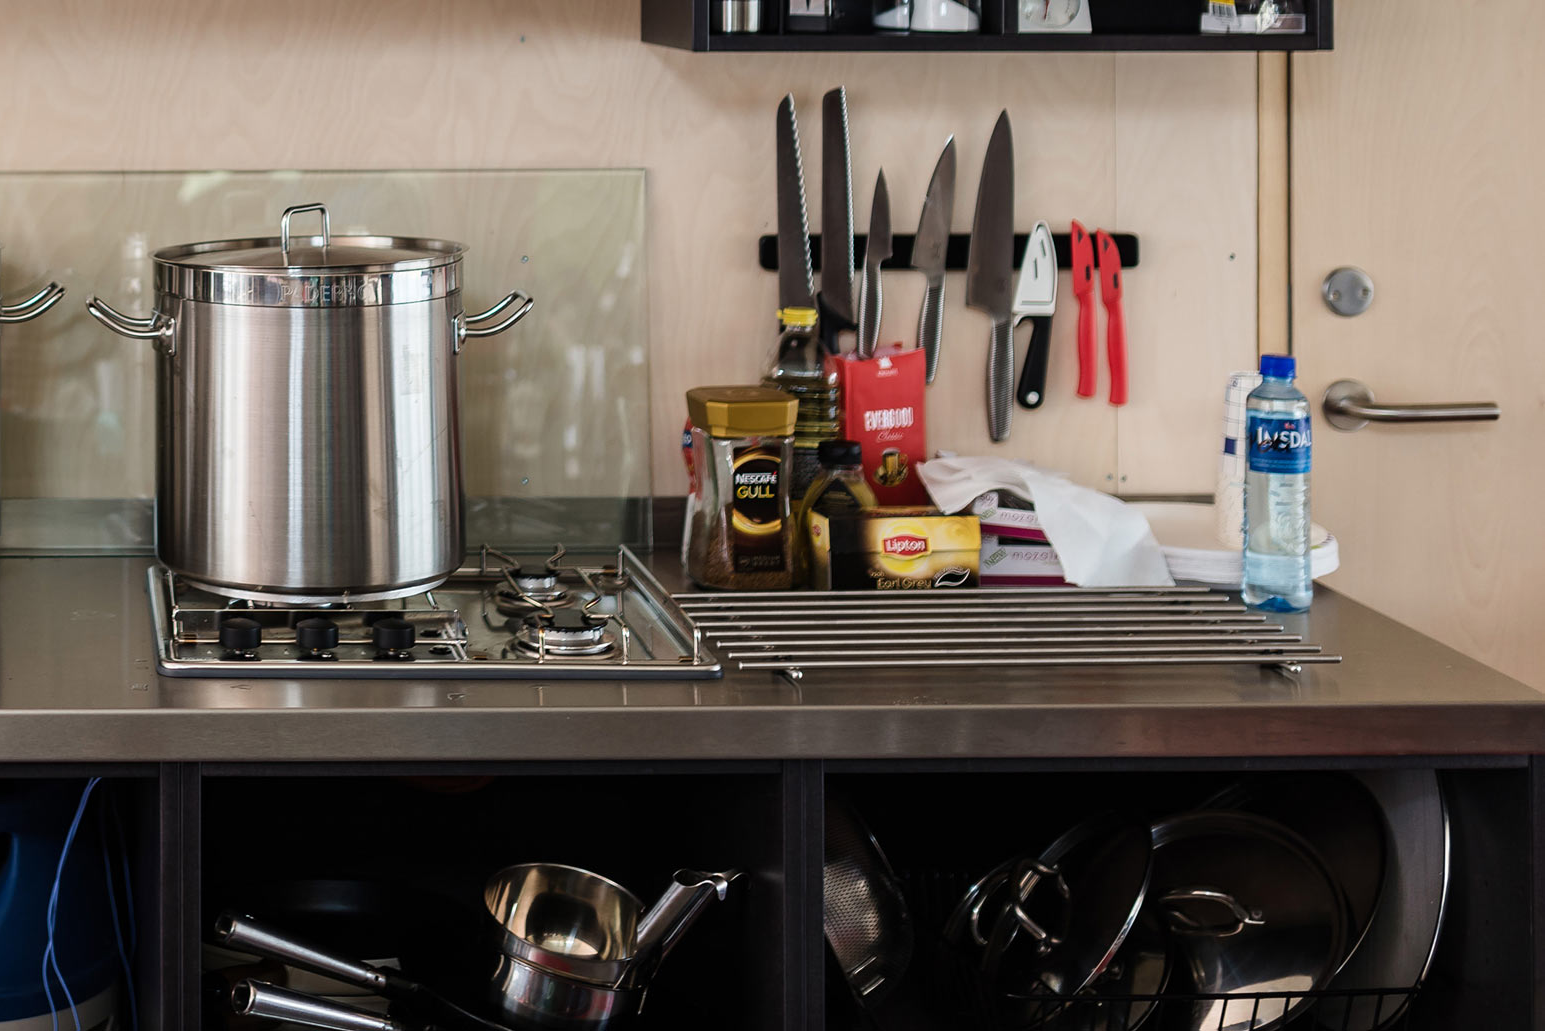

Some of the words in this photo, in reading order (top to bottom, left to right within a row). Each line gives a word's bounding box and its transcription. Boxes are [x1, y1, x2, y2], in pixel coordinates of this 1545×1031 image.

[864, 407, 913, 431] EVERGOOD
[735, 471, 778, 485] NESCAFÉ
[736, 485, 775, 499] GULL
[885, 537, 926, 553] Lipton
[877, 577, 901, 589] Earl
[902, 576, 932, 590] Grey
